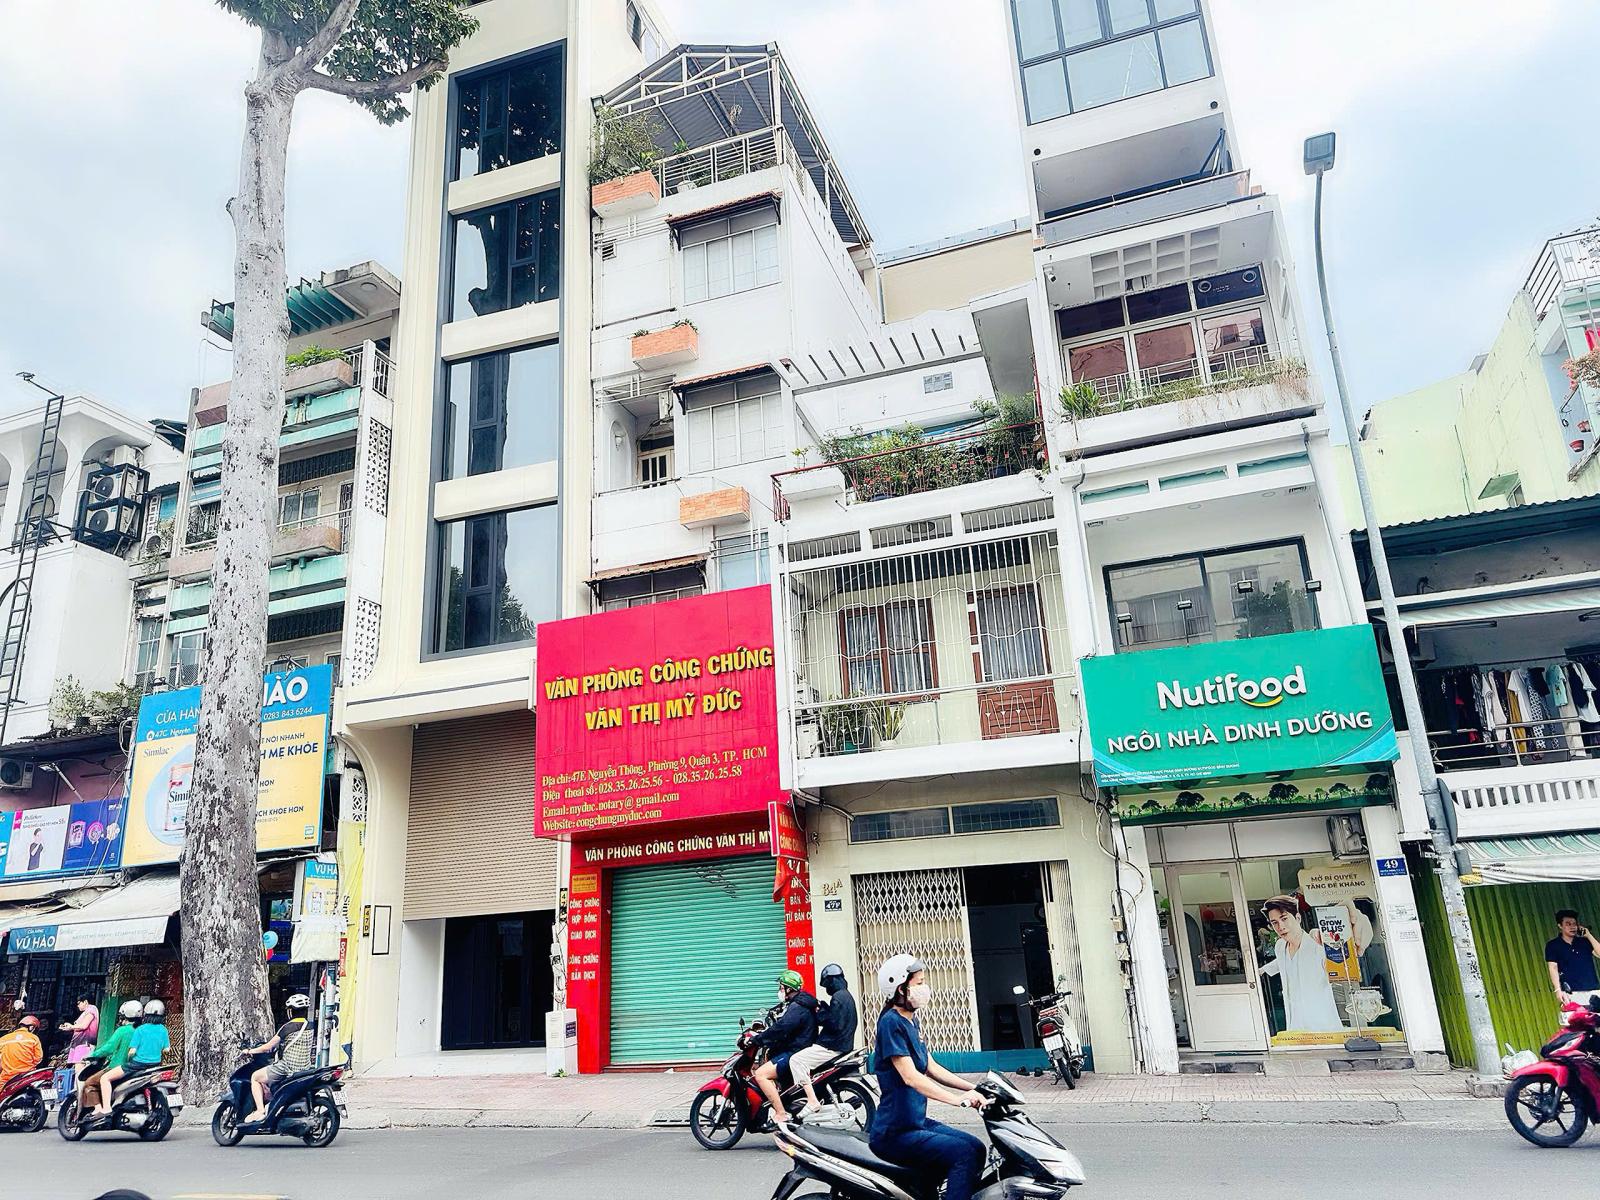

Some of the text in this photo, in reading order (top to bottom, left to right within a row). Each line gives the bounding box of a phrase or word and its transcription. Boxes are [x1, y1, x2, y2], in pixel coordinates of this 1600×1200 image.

[545, 646, 773, 700] VĂN PHÒNG CÔNG CHỨNG
[1156, 665, 1307, 710] Nutifood
[180, 706, 200, 721] HÀN
[263, 711, 280, 720] 0283
[281, 709, 295, 718] 843
[585, 686, 742, 731] VĂN THỊ MỸ ĐỨC
[1107, 709, 1374, 754] NGÔI NHÀ DINH DƯỠNG
[742, 746, 768, 760] HCM
[607, 842, 642, 860] PHÒNG
[645, 839, 674, 856] CÔNG
[678, 834, 713, 852] CHỨNG
[716, 832, 736, 848] VĂN
[738, 829, 756, 848] THỊ
[1384, 859, 1399, 869] 49
